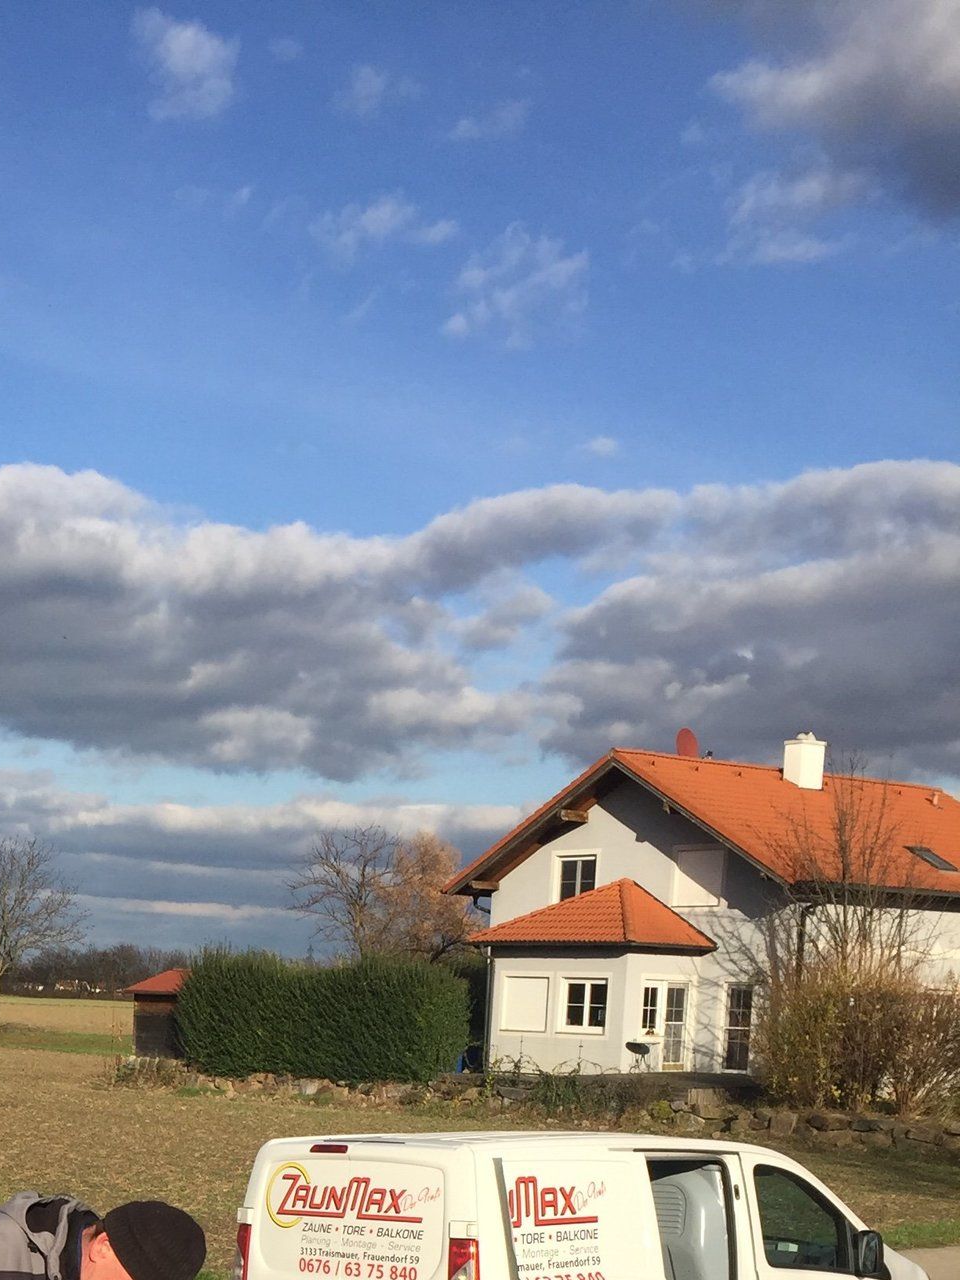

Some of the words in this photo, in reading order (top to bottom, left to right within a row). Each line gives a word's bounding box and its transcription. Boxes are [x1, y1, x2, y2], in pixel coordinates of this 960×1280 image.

[342, 1224, 366, 1236] TORE
[341, 1237, 378, 1251] Montage
[387, 1240, 421, 1253] Service
[520, 1232, 545, 1245] TORE
[300, 1247, 317, 1256] 3133
[318, 1248, 360, 1260] Traismauer,
[362, 1251, 409, 1264] Frauendorf
[409, 1255, 420, 1265] 59
[522, 1248, 559, 1260] Montage
[569, 1244, 599, 1256] Service
[298, 1257, 331, 1275] 0676
[344, 1261, 361, 1278] 63
[367, 1263, 384, 1280] 75
[547, 1256, 591, 1269] Frauendorf
[592, 1256, 601, 1266] 59
